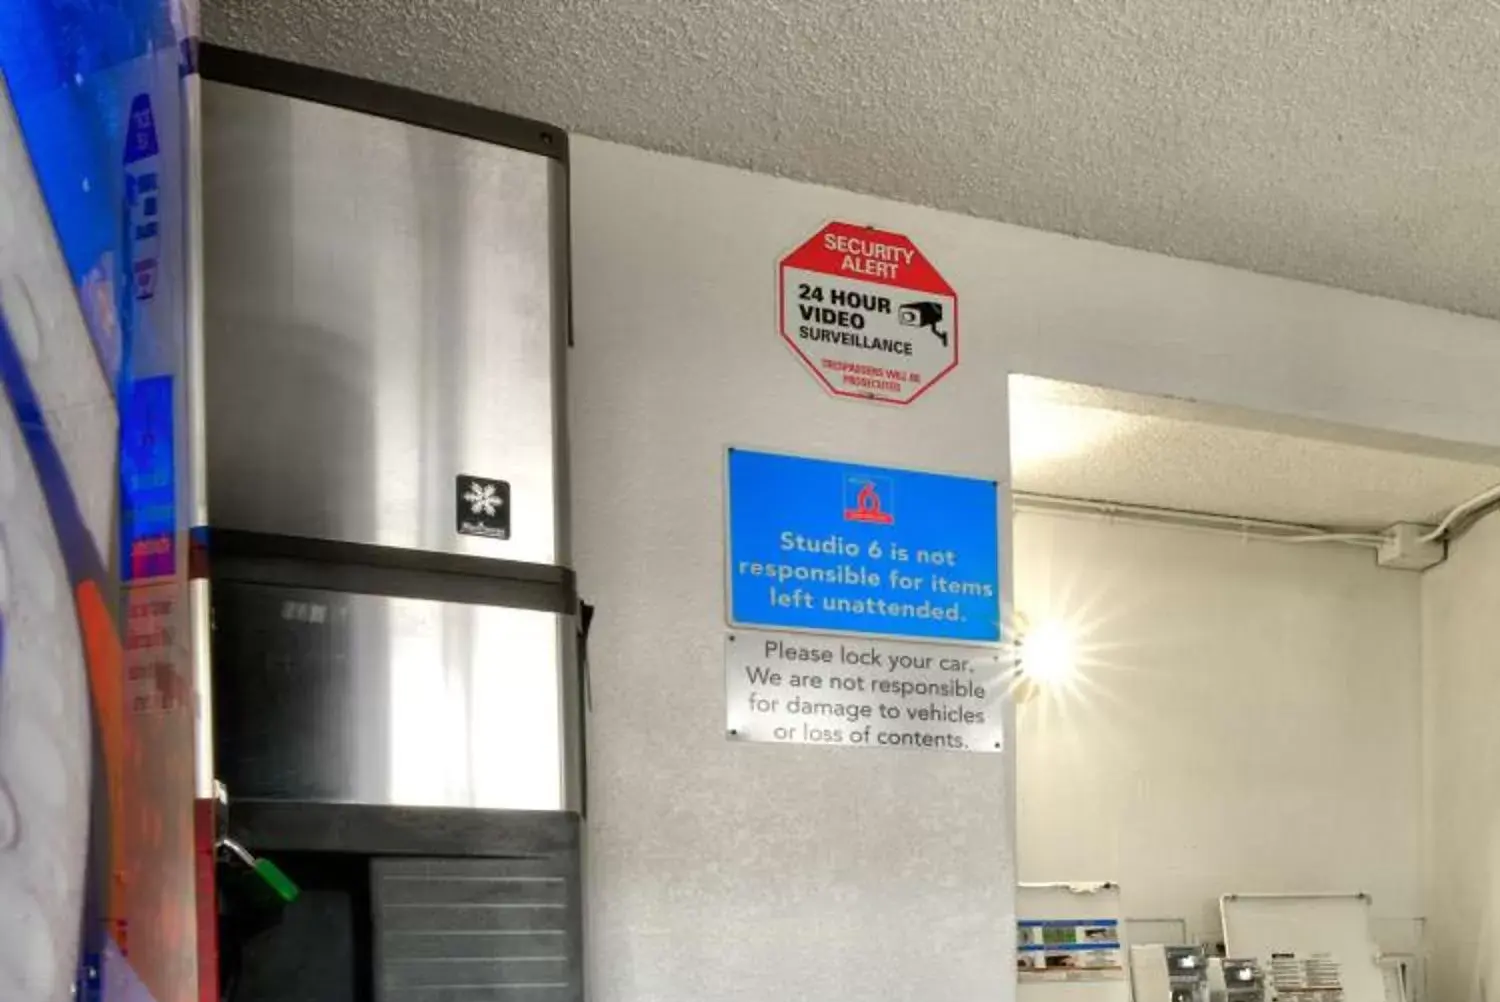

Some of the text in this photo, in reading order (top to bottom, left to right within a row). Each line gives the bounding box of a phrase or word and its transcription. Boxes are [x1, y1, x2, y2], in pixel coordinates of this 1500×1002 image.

[824, 233, 914, 264] SECURITY
[841, 255, 899, 279] ALERT
[798, 284, 891, 314] 24 HOUR
[799, 305, 865, 329] VIDEO
[800, 326, 913, 355] SURVEILLANCE
[781, 531, 956, 567] Studio 6 is not
[739, 559, 993, 597] responsible for items
[770, 587, 967, 622] left unattended.
[765, 641, 974, 673] Please lock your car.
[746, 666, 986, 699] We are not responsible
[748, 693, 985, 724] for damage to vehicles
[773, 722, 969, 749] or loss of contents.
